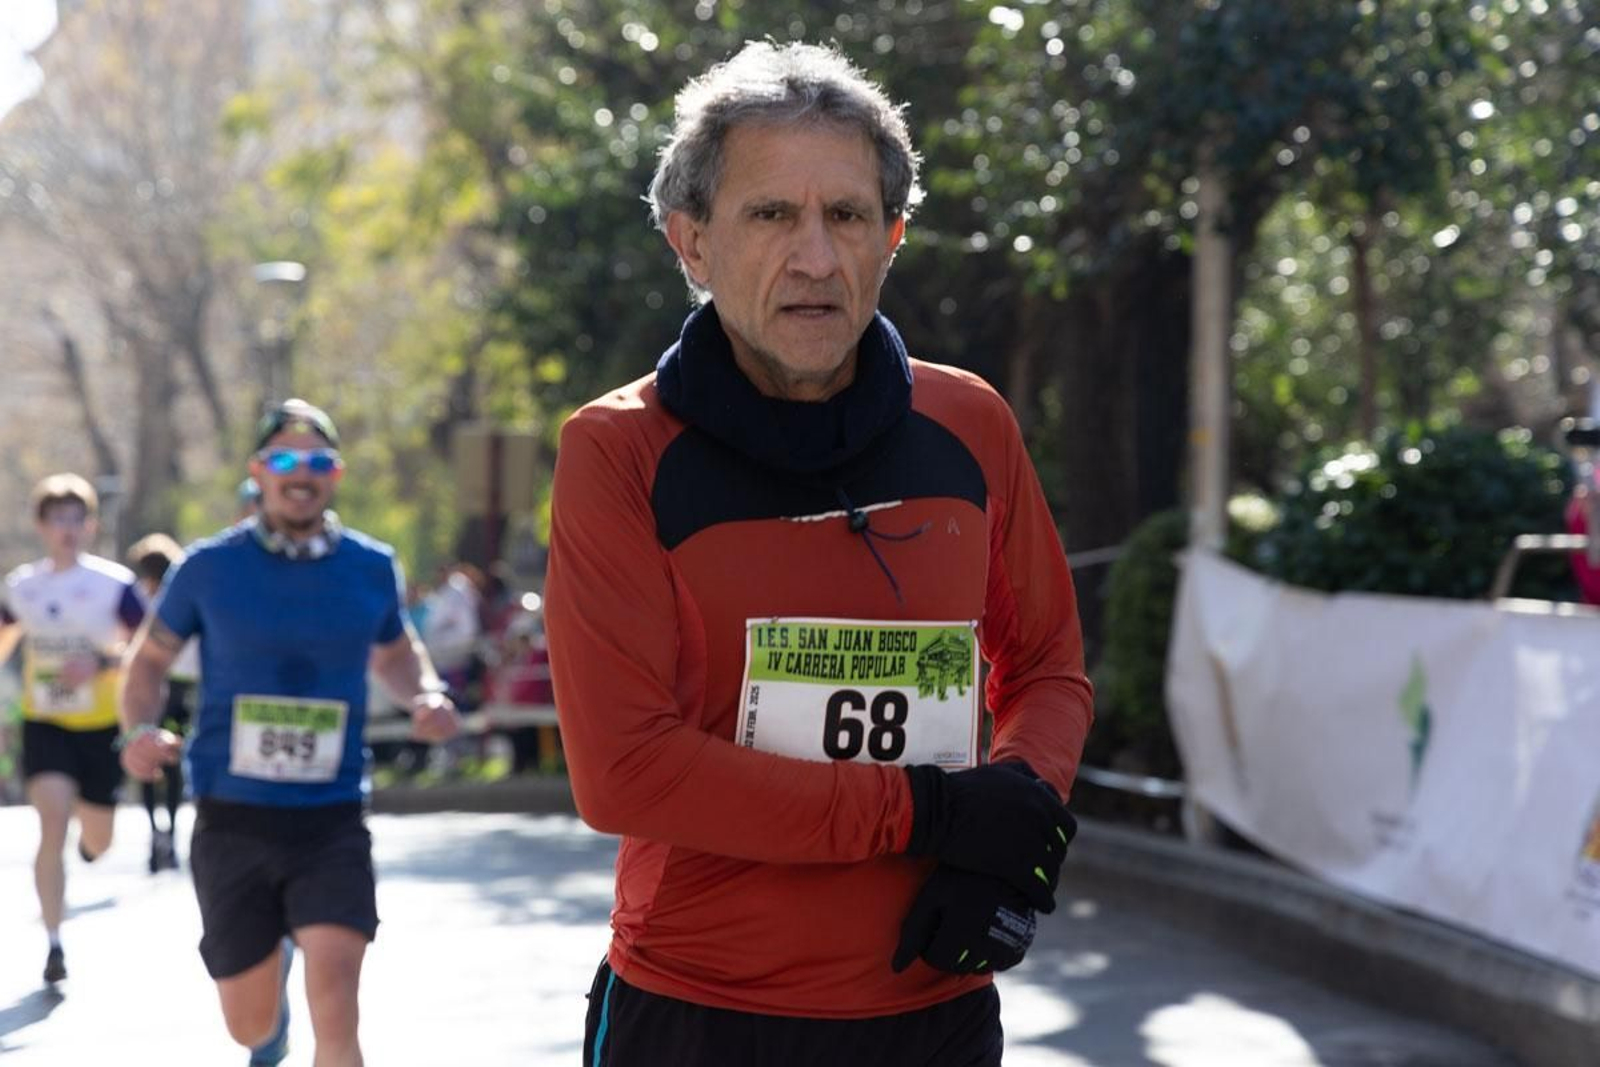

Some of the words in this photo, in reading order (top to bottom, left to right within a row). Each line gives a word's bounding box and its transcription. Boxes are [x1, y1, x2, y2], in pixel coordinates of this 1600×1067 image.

[757, 626, 792, 649] I.E.S.
[798, 627, 829, 651] SAN
[833, 628, 874, 651] JUAN
[877, 629, 918, 652] BOSCO
[767, 651, 783, 672] IV
[785, 652, 846, 681] CARRERA
[850, 654, 906, 681] POPULAR
[749, 684, 760, 705] 2025
[823, 689, 909, 762] 68
